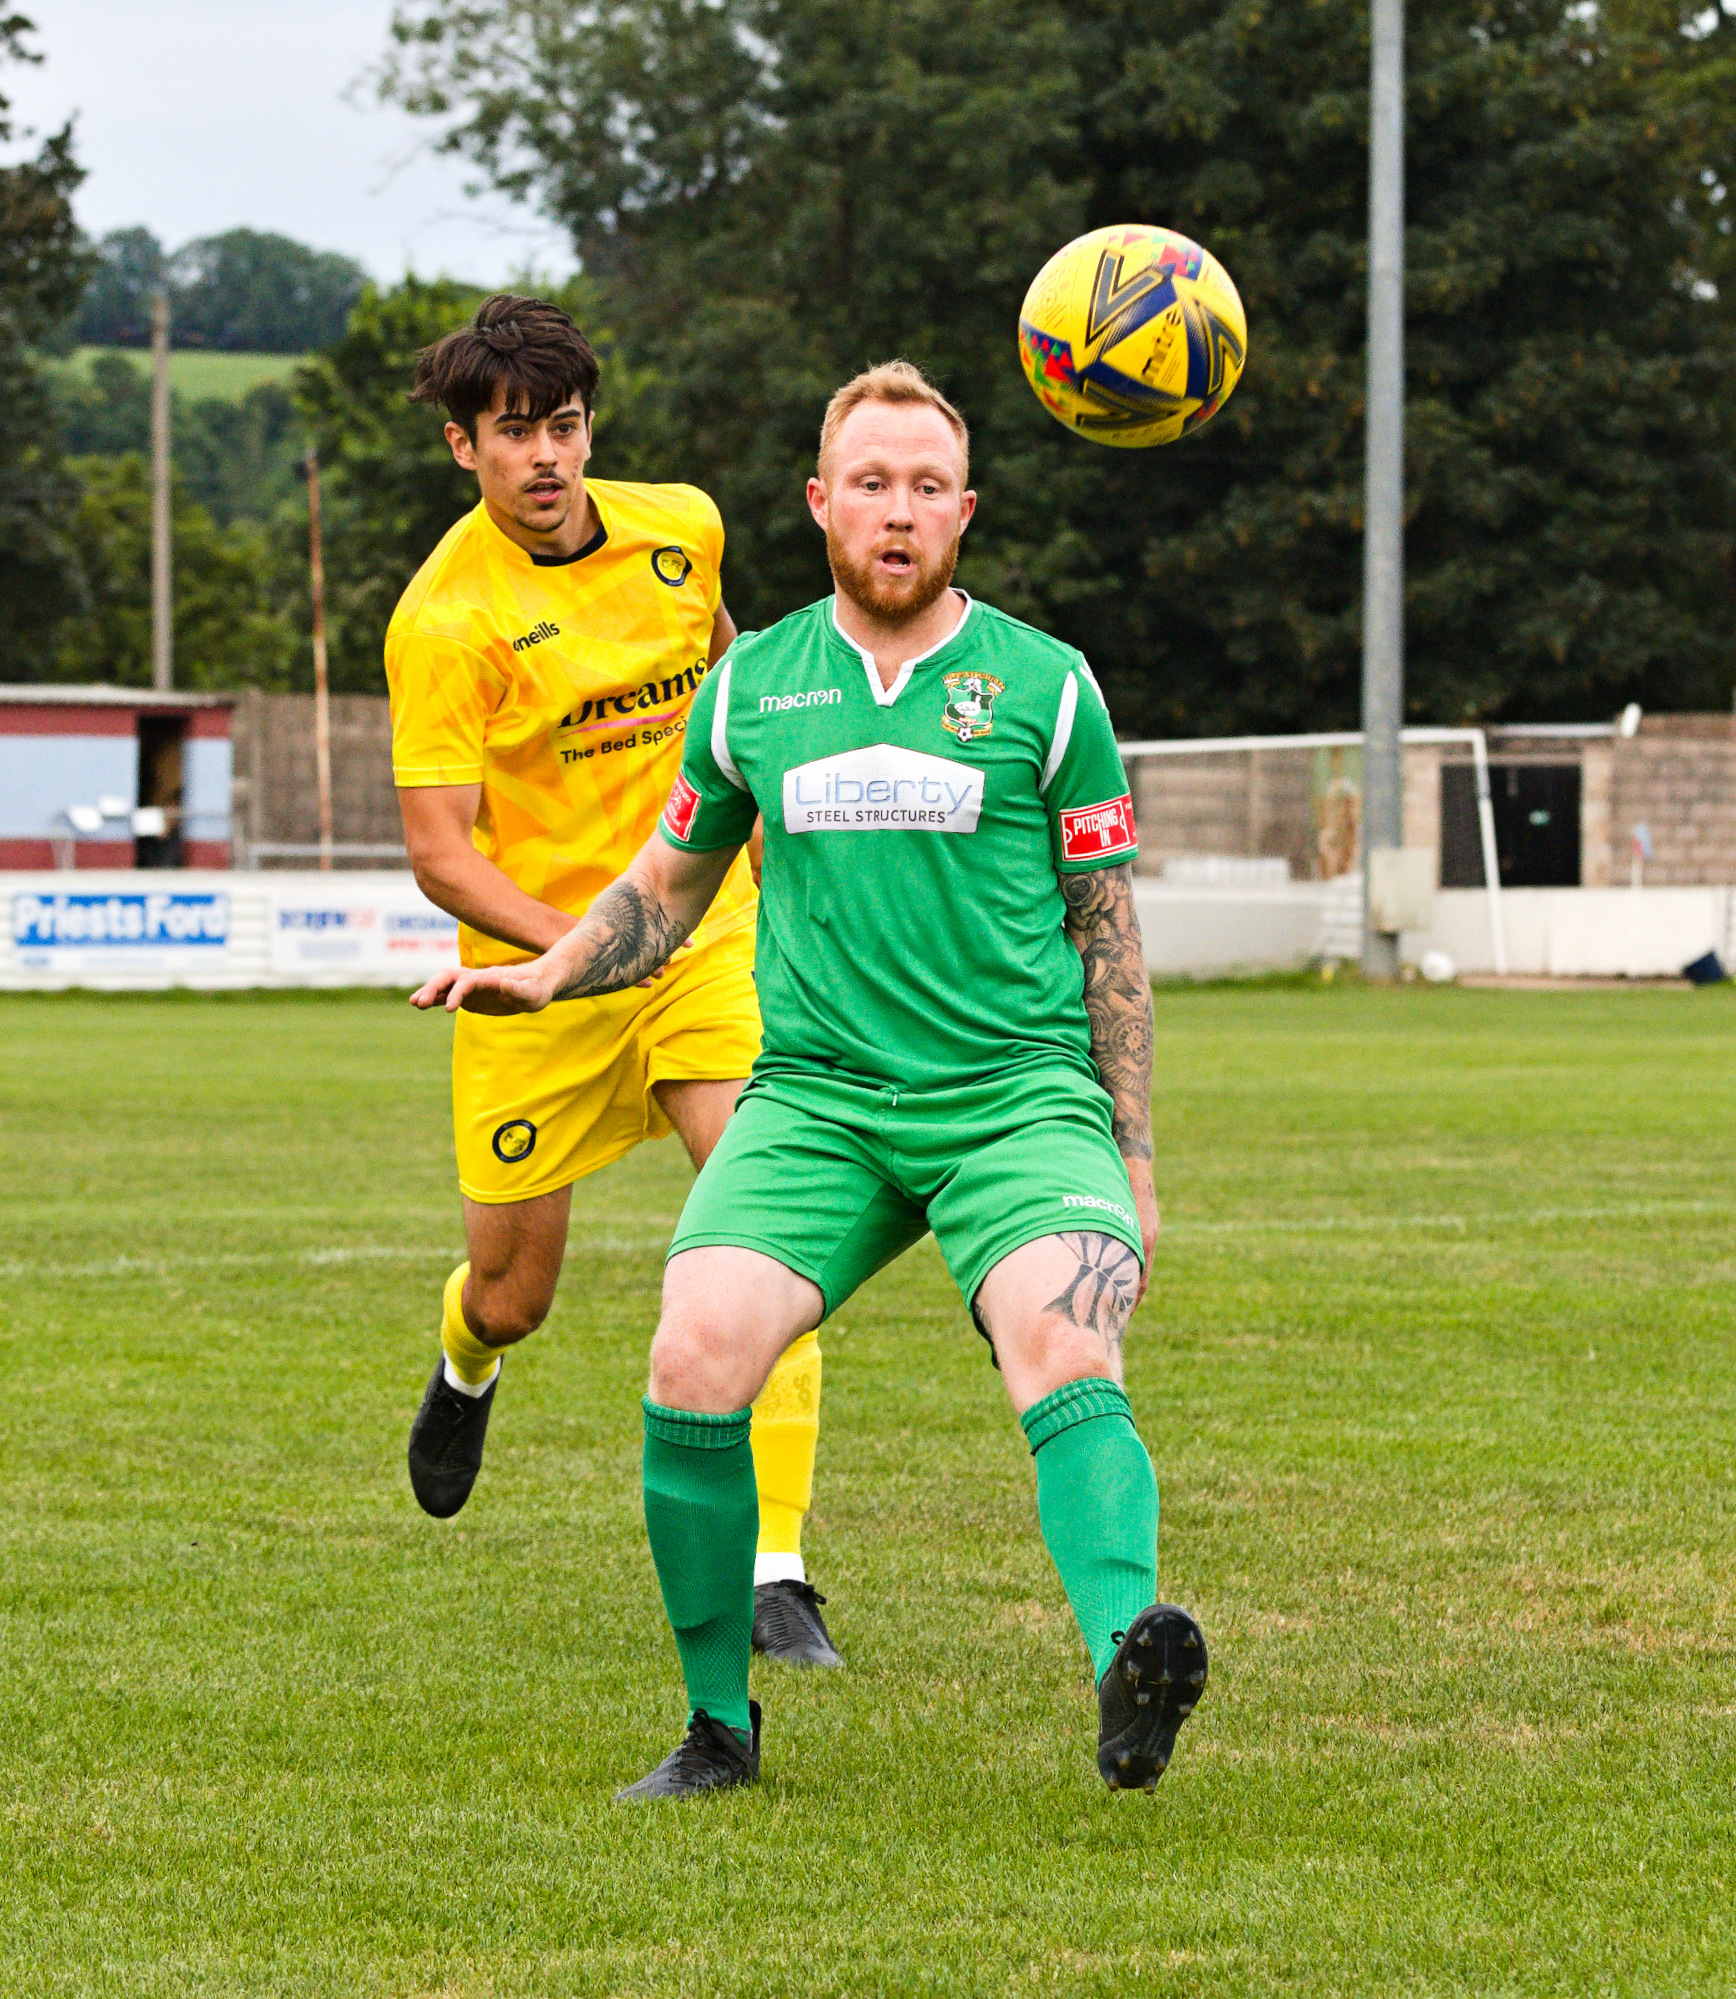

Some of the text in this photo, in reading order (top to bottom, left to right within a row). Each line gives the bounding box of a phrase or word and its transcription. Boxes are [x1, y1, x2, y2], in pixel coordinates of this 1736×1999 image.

[759, 687, 842, 713] macron
[560, 749, 594, 764] The
[601, 734, 636, 754] Bed
[795, 773, 973, 816] Liberty
[806, 809, 946, 823] STEEL STRUCTURES
[1073, 808, 1118, 835] PITCHING
[1100, 828, 1111, 848] IN
[1062, 1195, 1135, 1229] macron
